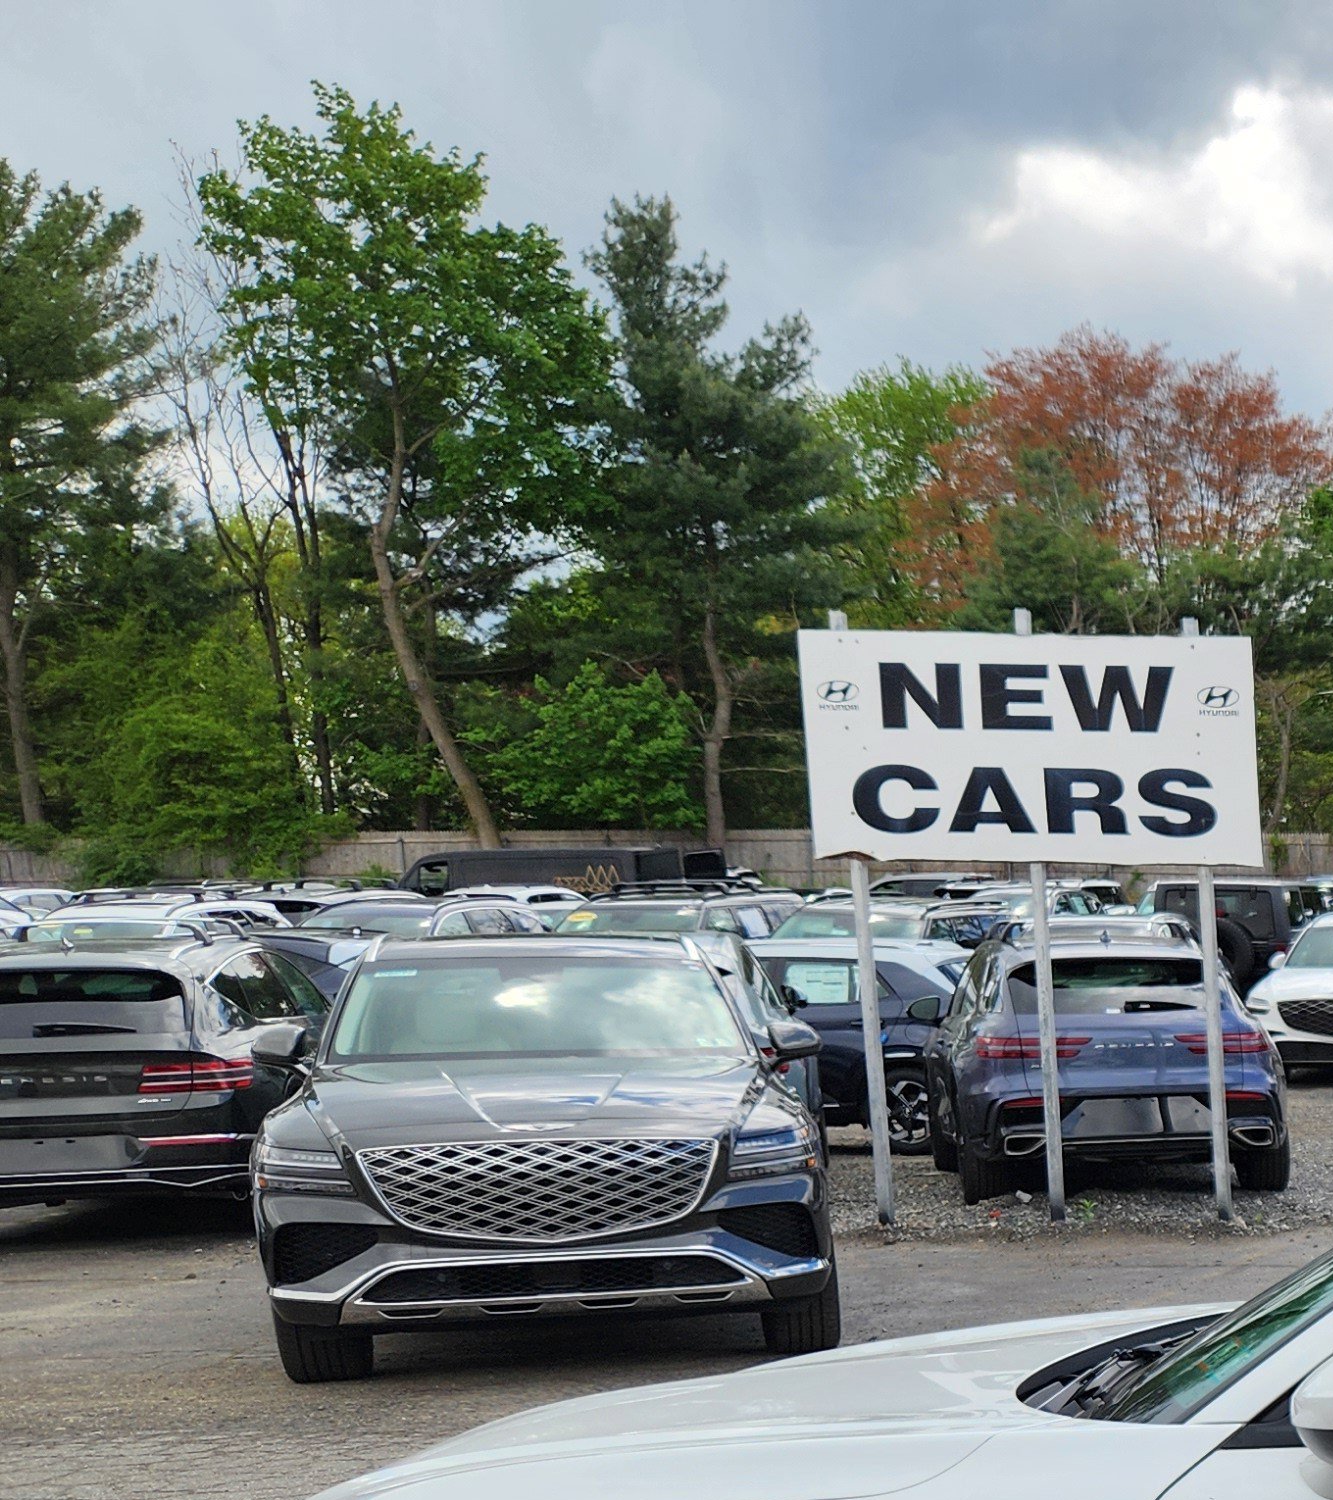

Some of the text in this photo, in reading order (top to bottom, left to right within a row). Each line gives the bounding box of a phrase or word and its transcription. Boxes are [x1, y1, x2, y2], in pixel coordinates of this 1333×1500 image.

[818, 703, 860, 711] HYUNDAI
[877, 661, 1174, 733] NEW
[1198, 709, 1240, 717] HYUNDAI
[852, 763, 1218, 838] CARS
